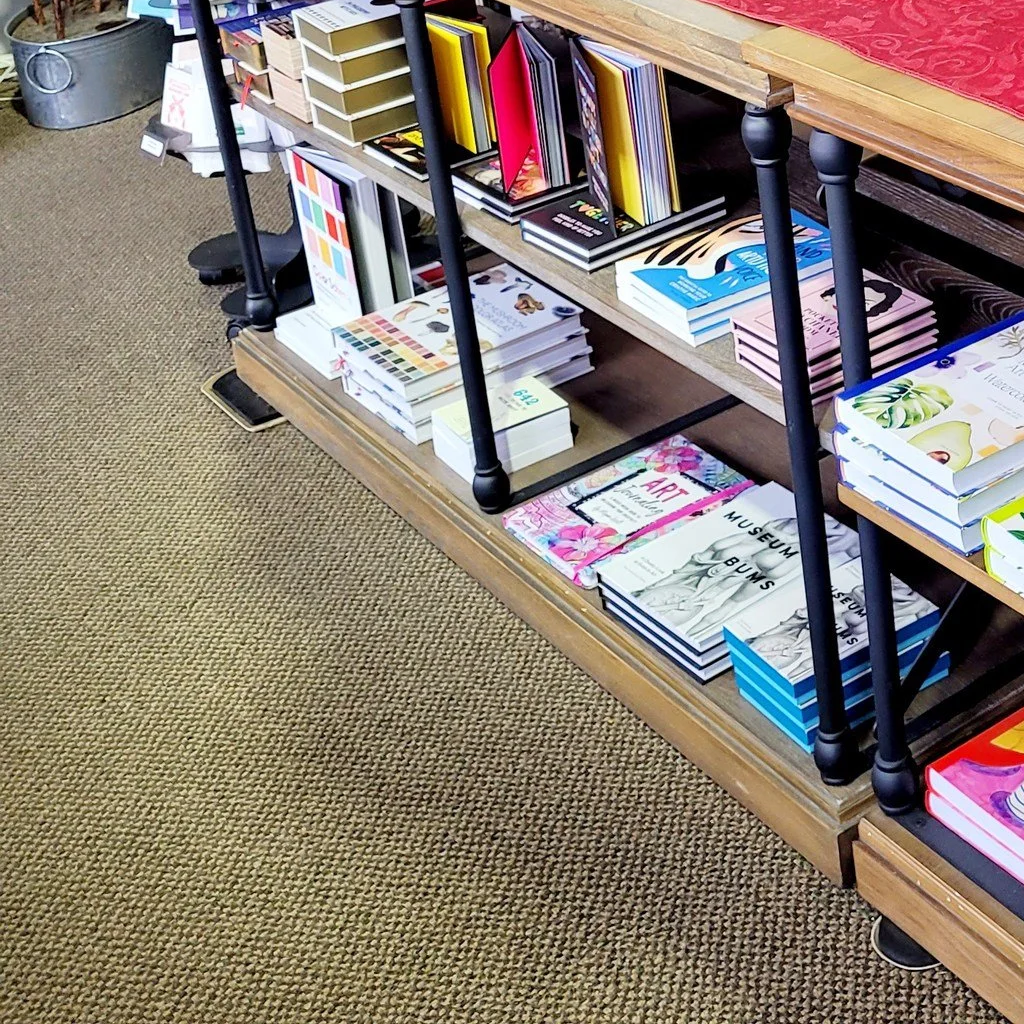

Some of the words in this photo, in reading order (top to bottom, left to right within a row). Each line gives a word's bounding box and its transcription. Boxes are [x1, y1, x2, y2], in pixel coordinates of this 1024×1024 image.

[512, 388, 540, 407] 642
[641, 476, 690, 503] ART
[723, 510, 800, 560] MUSEUM
[723, 556, 776, 591] BUMS
